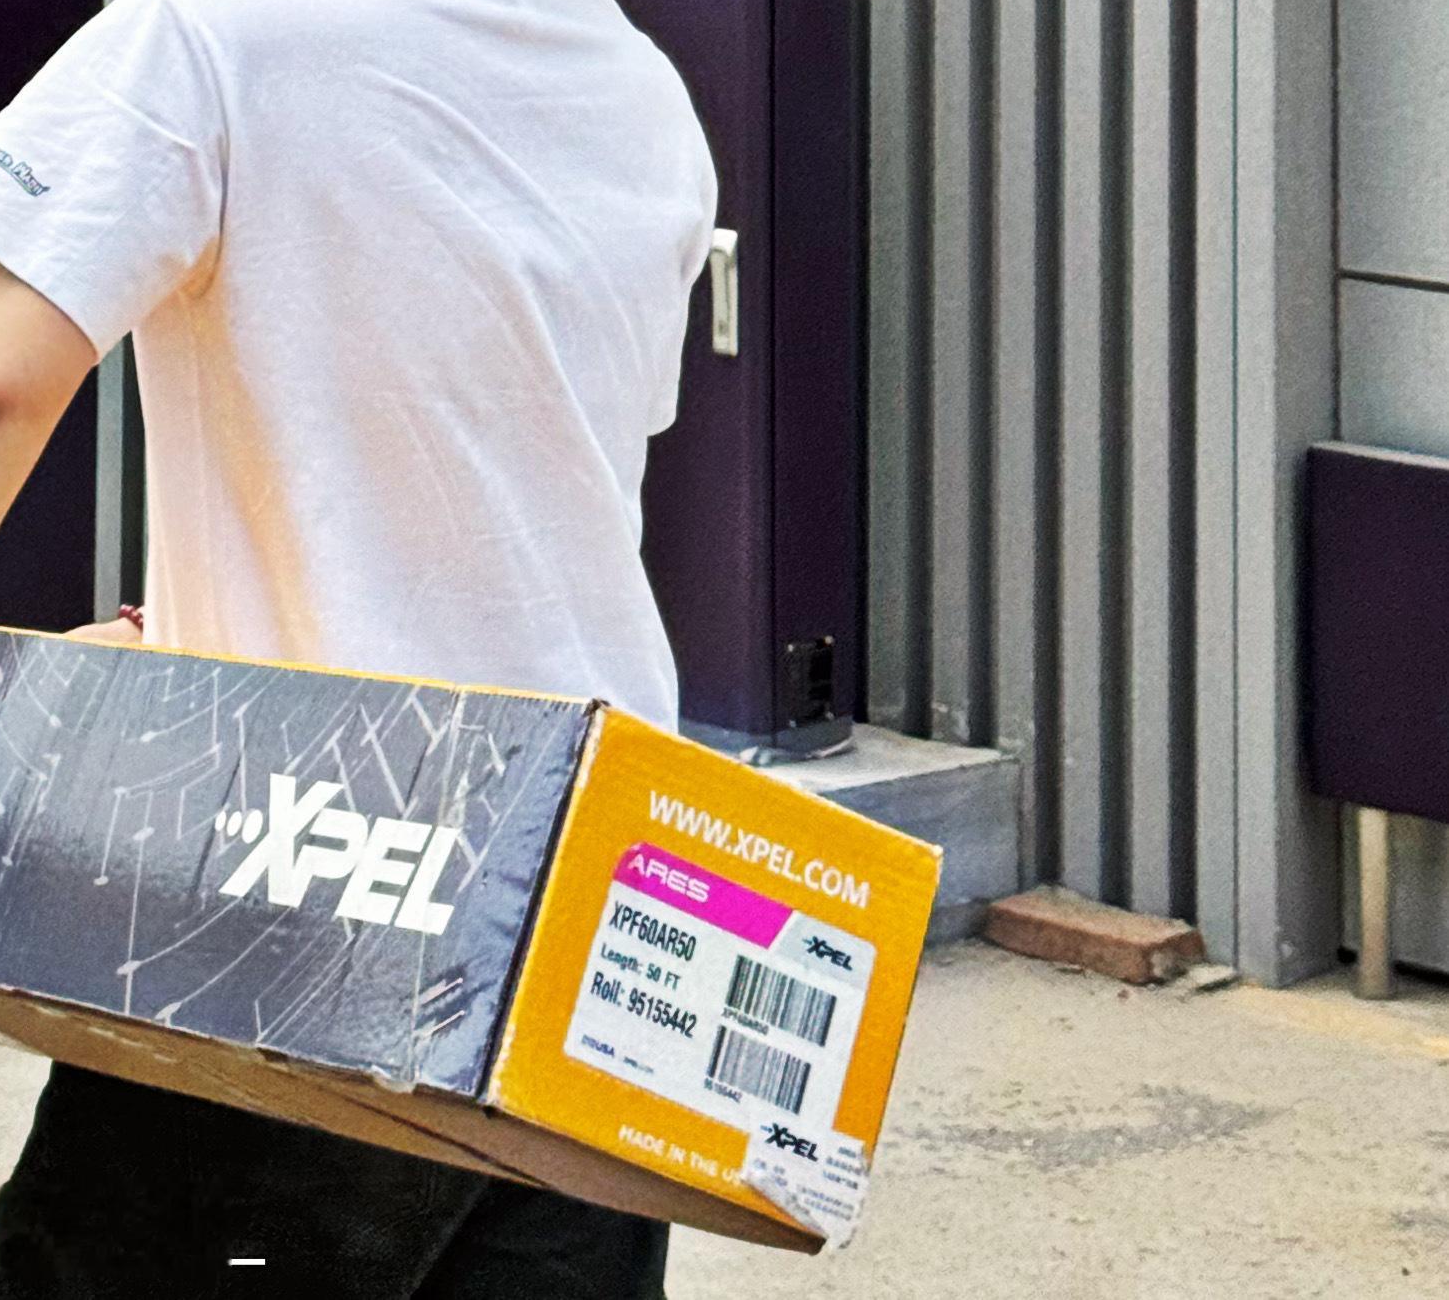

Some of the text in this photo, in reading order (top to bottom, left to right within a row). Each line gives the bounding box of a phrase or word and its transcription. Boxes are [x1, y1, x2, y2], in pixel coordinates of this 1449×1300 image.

[217, 772, 462, 935] XPEL
[649, 790, 871, 909] WWW.XPEL.COM
[628, 853, 711, 903] ARES
[609, 900, 697, 962] XPF60AR50
[806, 936, 853, 971] XPEL
[646, 962, 662, 983] 50
[664, 971, 682, 990] FT
[590, 971, 698, 1039] Roll: 95155442
[618, 1124, 665, 1157] MADE
[669, 1142, 684, 1164] IN
[690, 1150, 719, 1177] THE
[764, 1123, 819, 1162] XPEL
